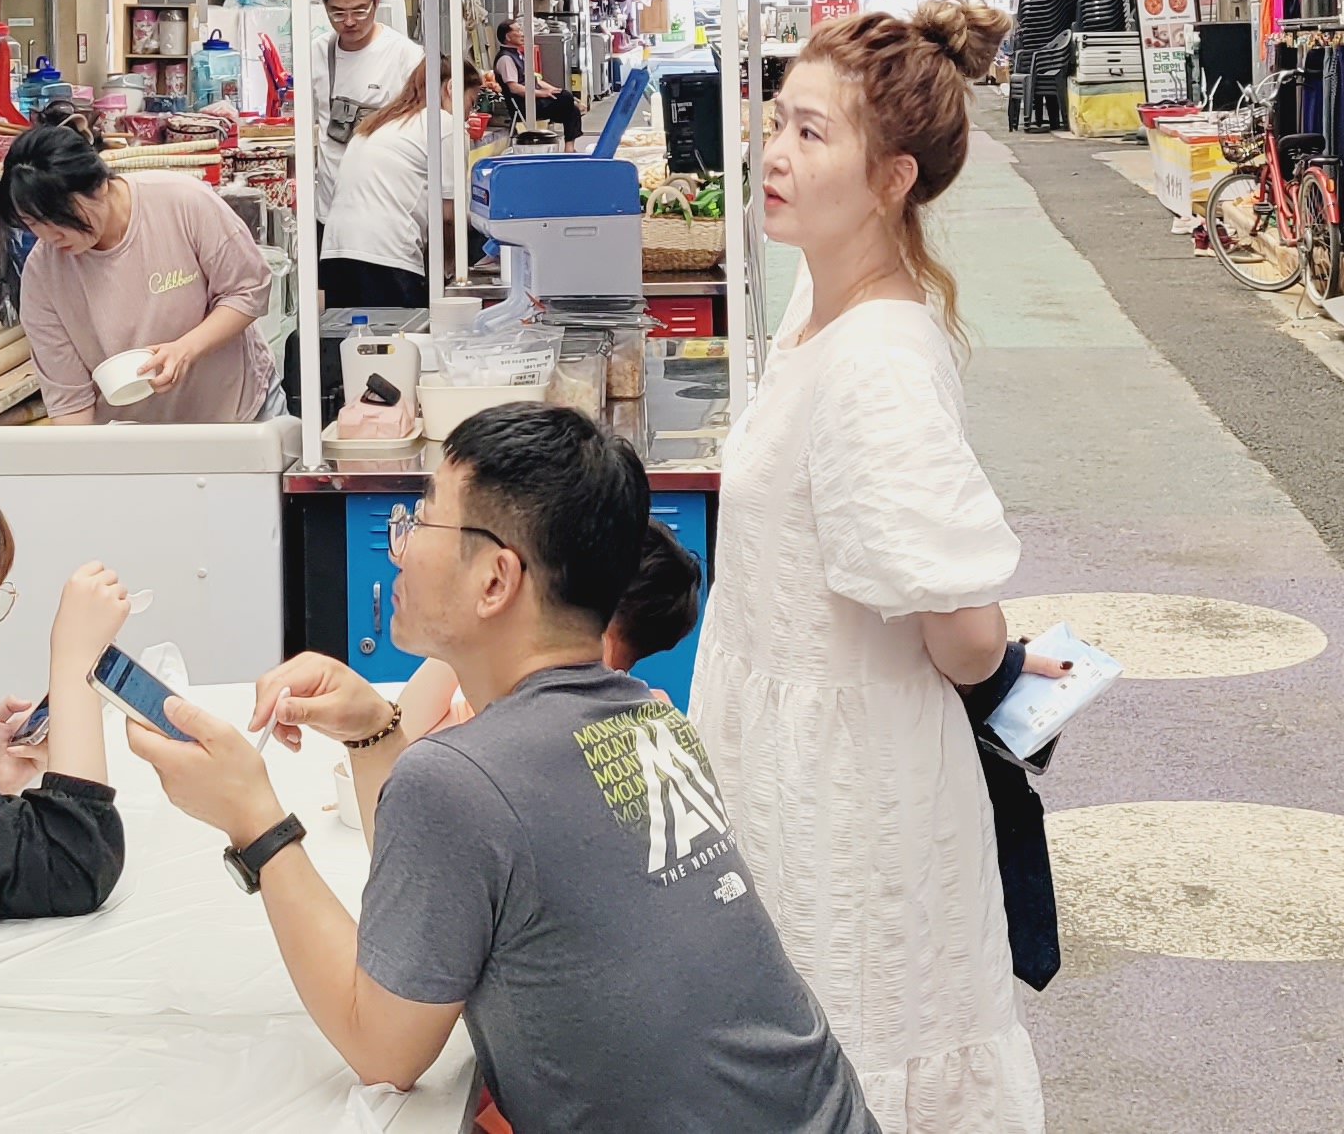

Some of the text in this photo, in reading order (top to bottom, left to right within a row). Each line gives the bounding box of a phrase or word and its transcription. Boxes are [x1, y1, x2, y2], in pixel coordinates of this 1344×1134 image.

[1152, 52, 1170, 63] 전국
[572, 709, 636, 750] MOUNTAIN
[660, 863, 688, 887] THE
[690, 839, 730, 871] NORTH
[717, 873, 733, 887] THE
[713, 882, 735, 900] NORTH
